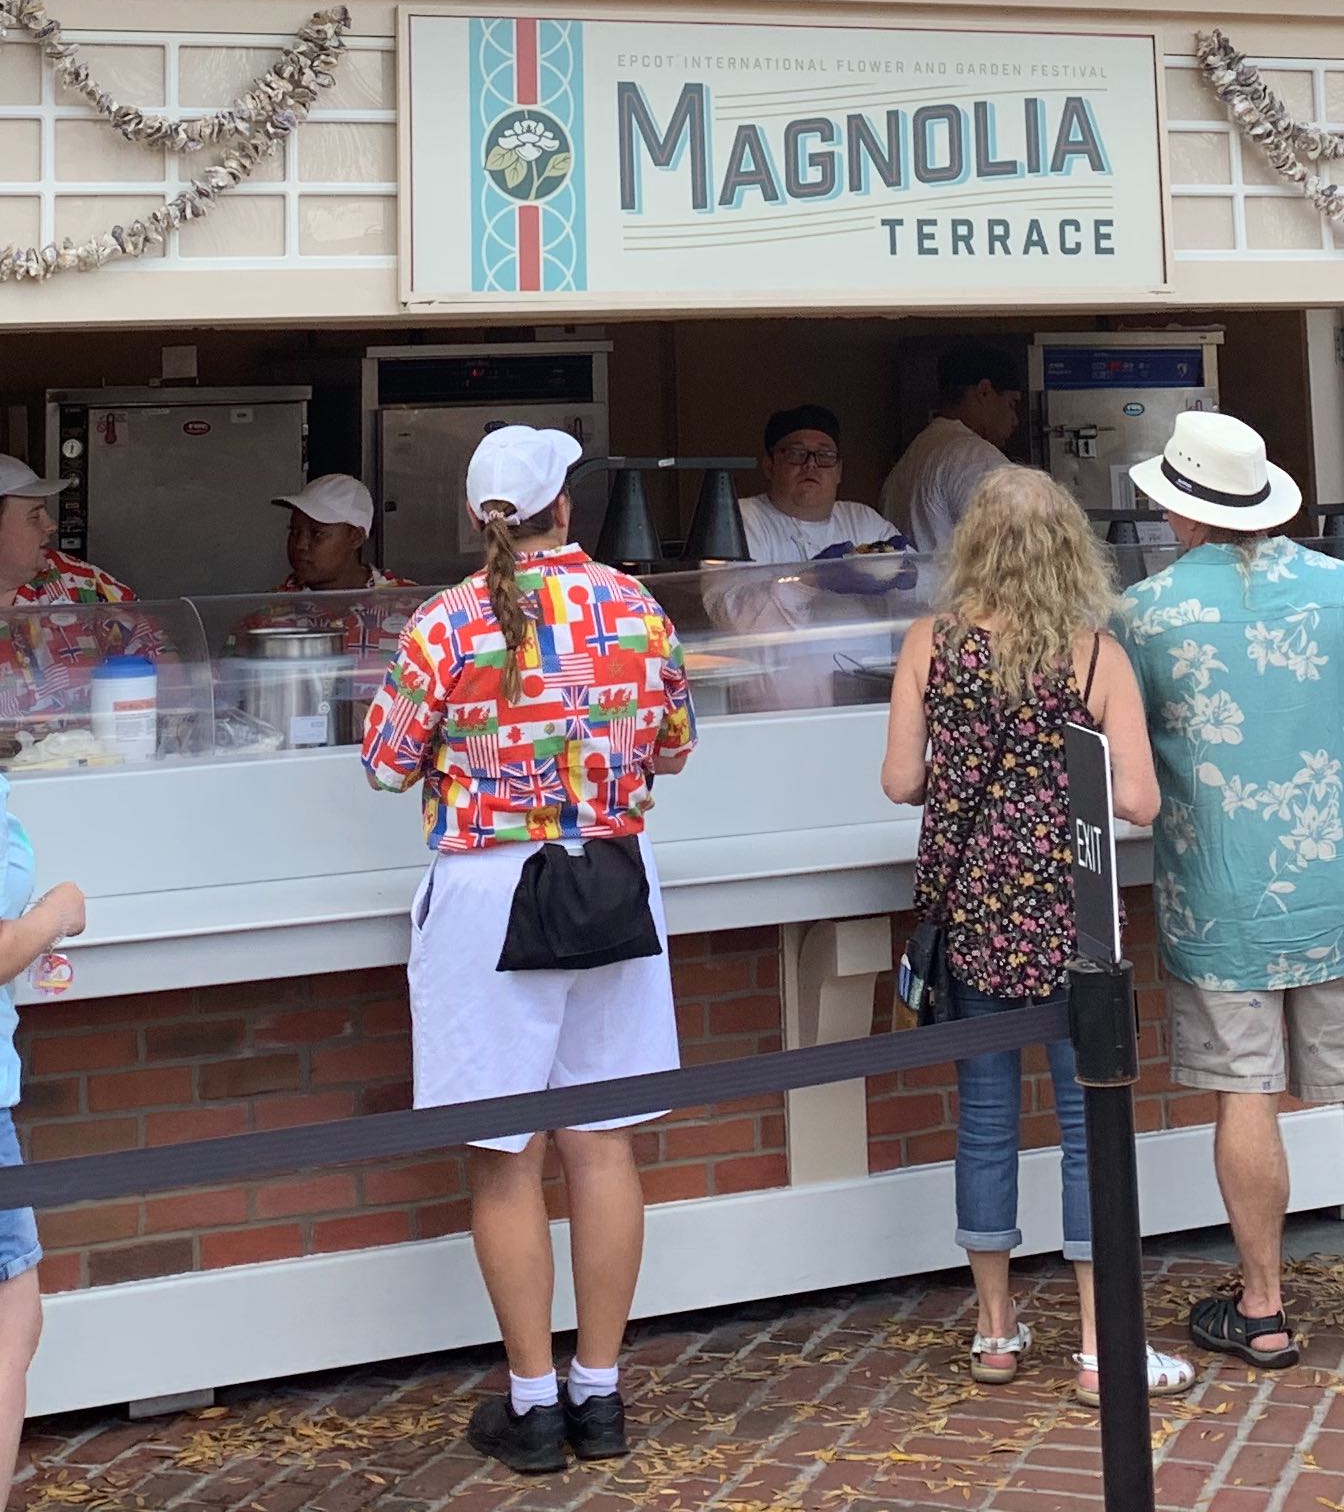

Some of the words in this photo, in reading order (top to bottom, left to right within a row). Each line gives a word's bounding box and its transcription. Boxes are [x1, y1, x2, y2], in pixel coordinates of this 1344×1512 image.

[617, 54, 674, 68] EPCOT
[684, 55, 828, 72] INTERNATIONAL
[837, 59, 905, 74] FLOWER
[913, 61, 947, 75] AND
[956, 62, 1022, 77] GARDEN
[1031, 64, 1108, 79] FESTIVAL
[617, 80, 1112, 215] MAGNOLIA
[880, 218, 1115, 256] TERRACE
[1076, 818, 1102, 875] EXIT
